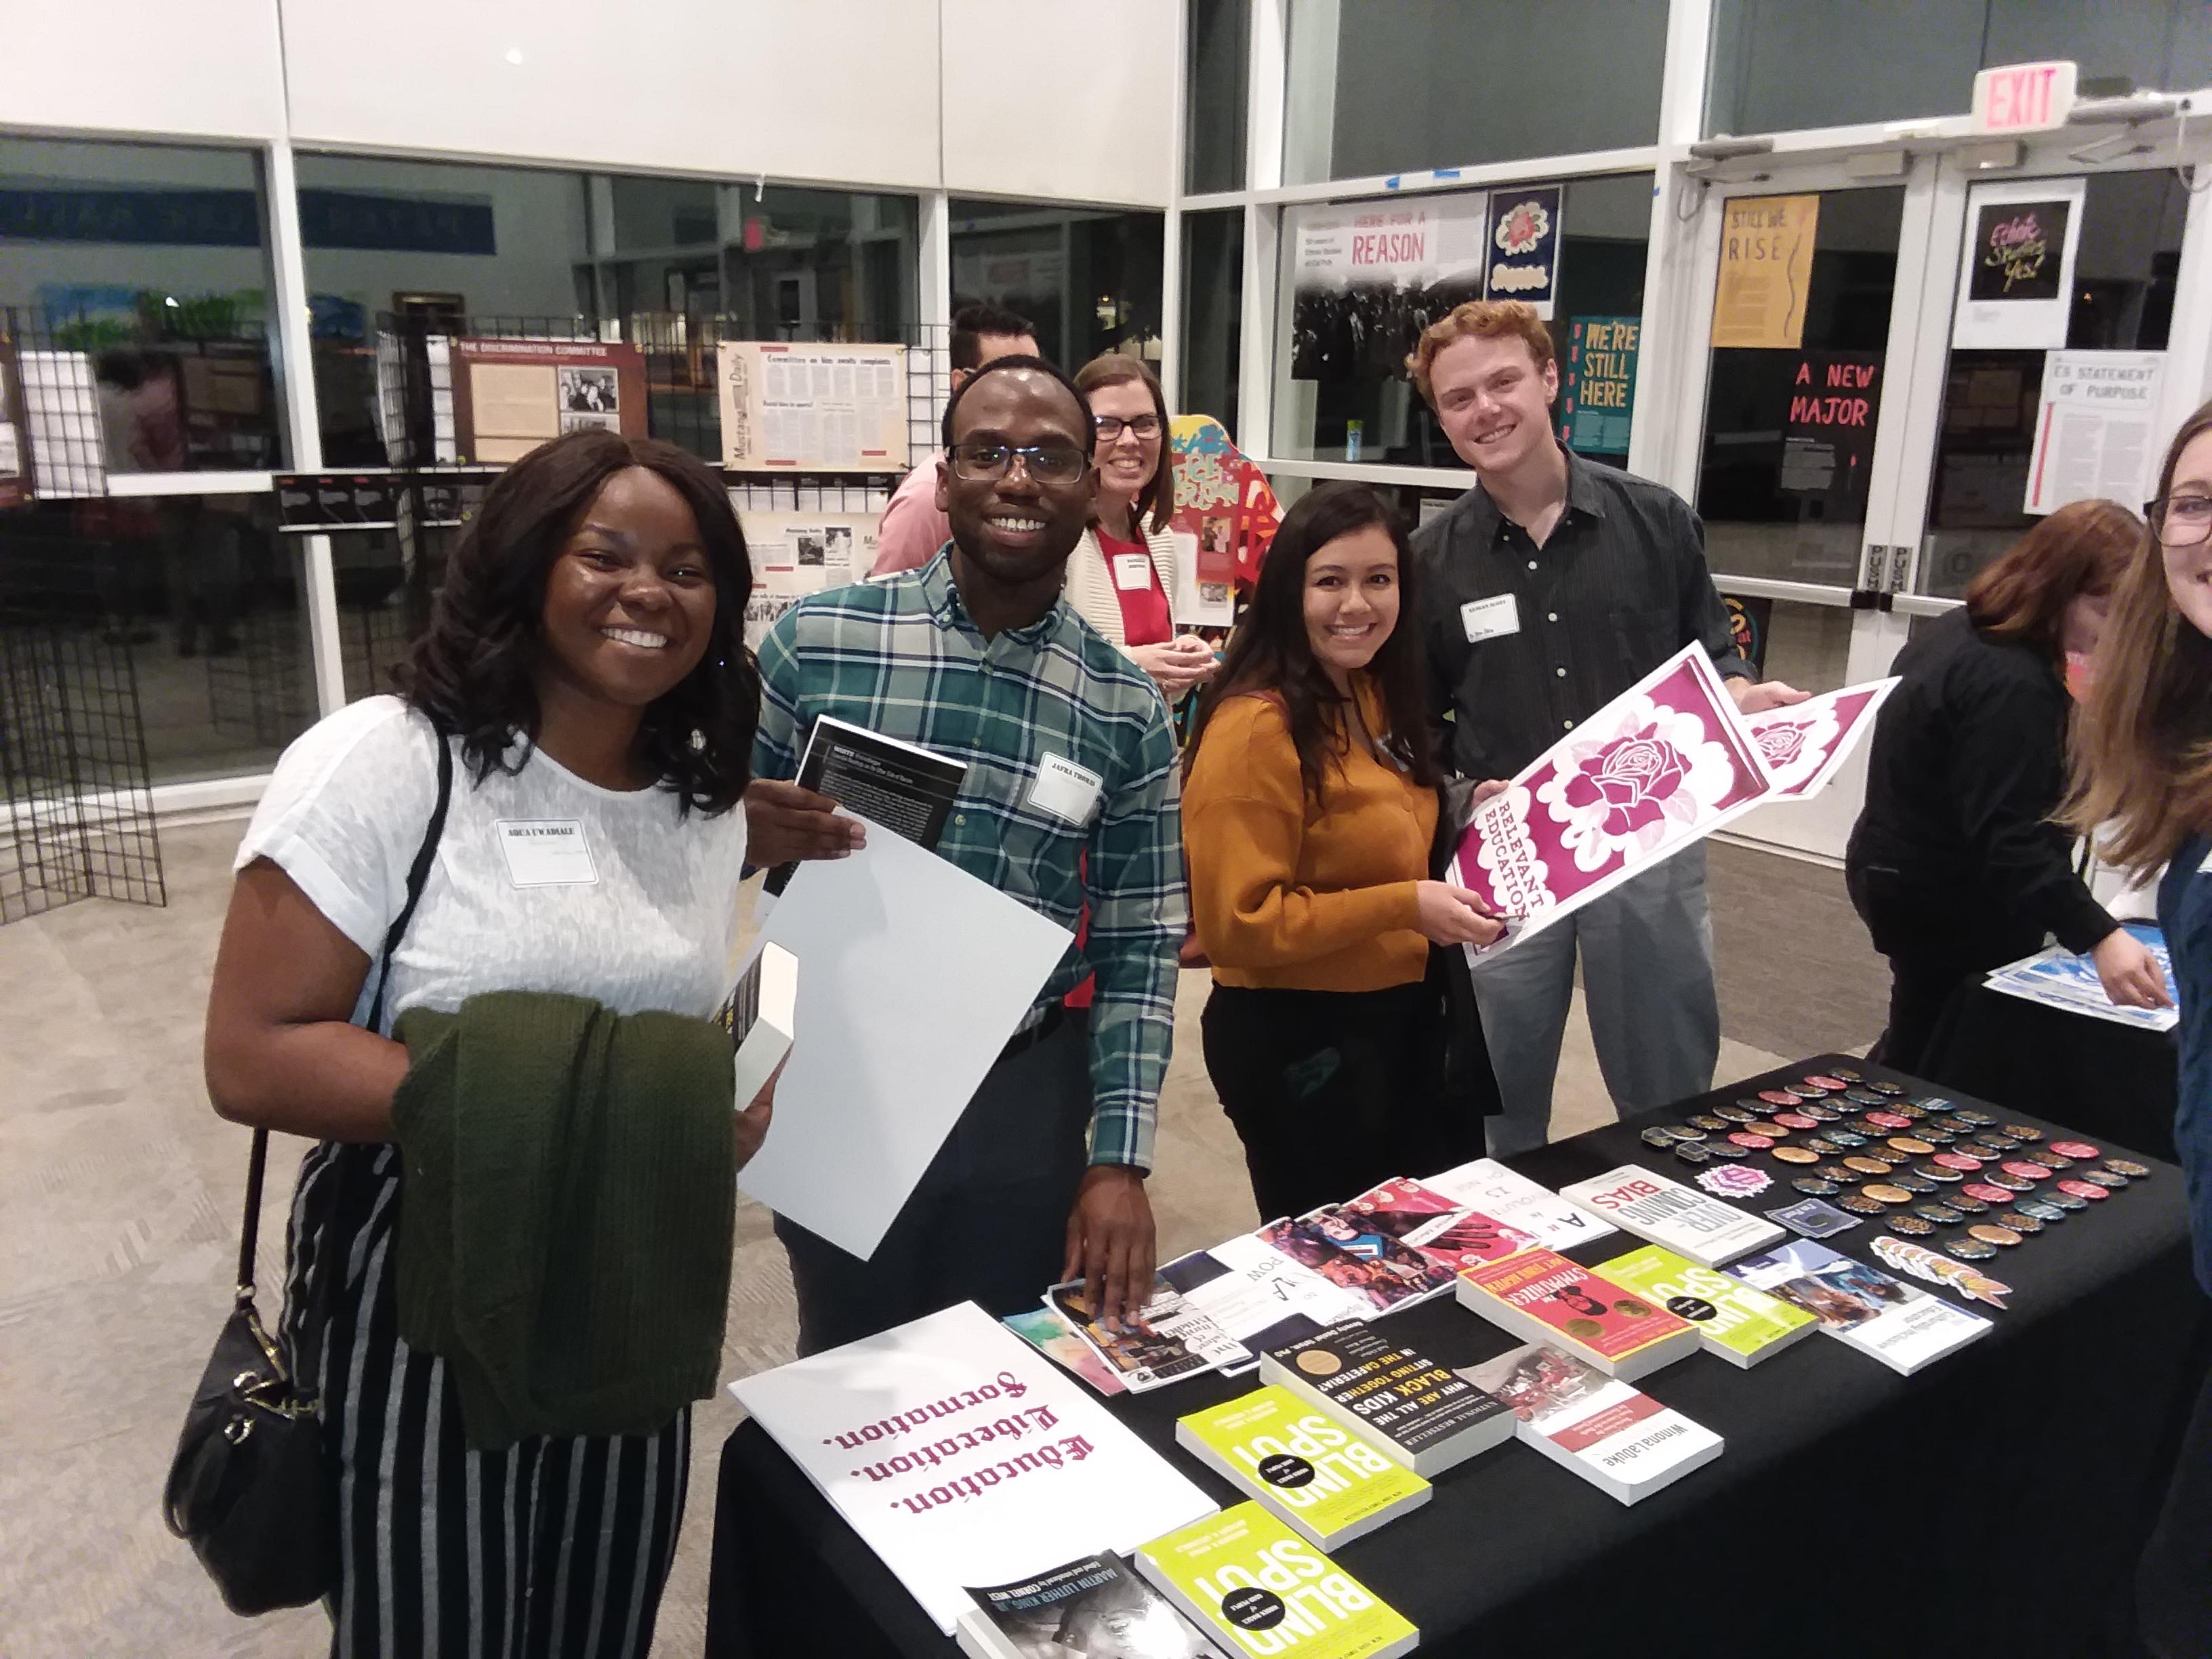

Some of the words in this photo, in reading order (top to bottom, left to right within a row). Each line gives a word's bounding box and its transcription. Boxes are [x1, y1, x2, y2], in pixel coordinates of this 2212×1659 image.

[1987, 66, 2056, 127] EXIT
[1352, 232, 1424, 265] REASON
[1729, 237, 1782, 260] RISE
[1584, 352, 1630, 380] STILL
[1795, 362, 1810, 385] A
[1827, 364, 1875, 388] NEW
[1580, 380, 1628, 407] HERE
[2087, 385, 2148, 399] PURPOSE
[1790, 396, 1868, 426] MAJOR
[1499, 800, 1544, 907] RELEVANT
[1591, 1180, 1662, 1209] BIAS
[1618, 1187, 1706, 1225] COMING
[1507, 1267, 1589, 1306] SYMPATHIZER
[1639, 1268, 1732, 1309] SPOT
[1697, 1288, 1779, 1334] BLIND
[1378, 1353, 1403, 1365] THE
[1402, 1348, 1417, 1358] IN
[1317, 1360, 1378, 1391] CAFETERIA?
[1390, 1358, 1433, 1378] SITTING
[1394, 1367, 1452, 1396] BLACK
[1334, 1373, 1394, 1402] TOGETHER
[1417, 1390, 1441, 1406] ARE
[1440, 1381, 1469, 1396] WHY
[822, 1371, 1027, 1449] Formation.
[1352, 1391, 1399, 1415] KIDS
[1397, 1400, 1419, 1414] ALL
[1372, 1409, 1398, 1426] THE
[851, 1405, 1060, 1481] Liberation.
[1232, 1415, 1348, 1480] SPOT
[1641, 1424, 1689, 1451] Winona
[1602, 1441, 1647, 1467] LaDuke
[890, 1435, 1094, 1514] Education.
[1267, 1442, 1394, 1507] BLIND
[1009, 1583, 1041, 1600] CORNEL
[1046, 1582, 1077, 1602] LUTHER
[1078, 1568, 1118, 1589] MARTIN
[1193, 1539, 1324, 1620] SPOT
[987, 1591, 1010, 1601] WEST
[1233, 1572, 1375, 1656] BLIND
